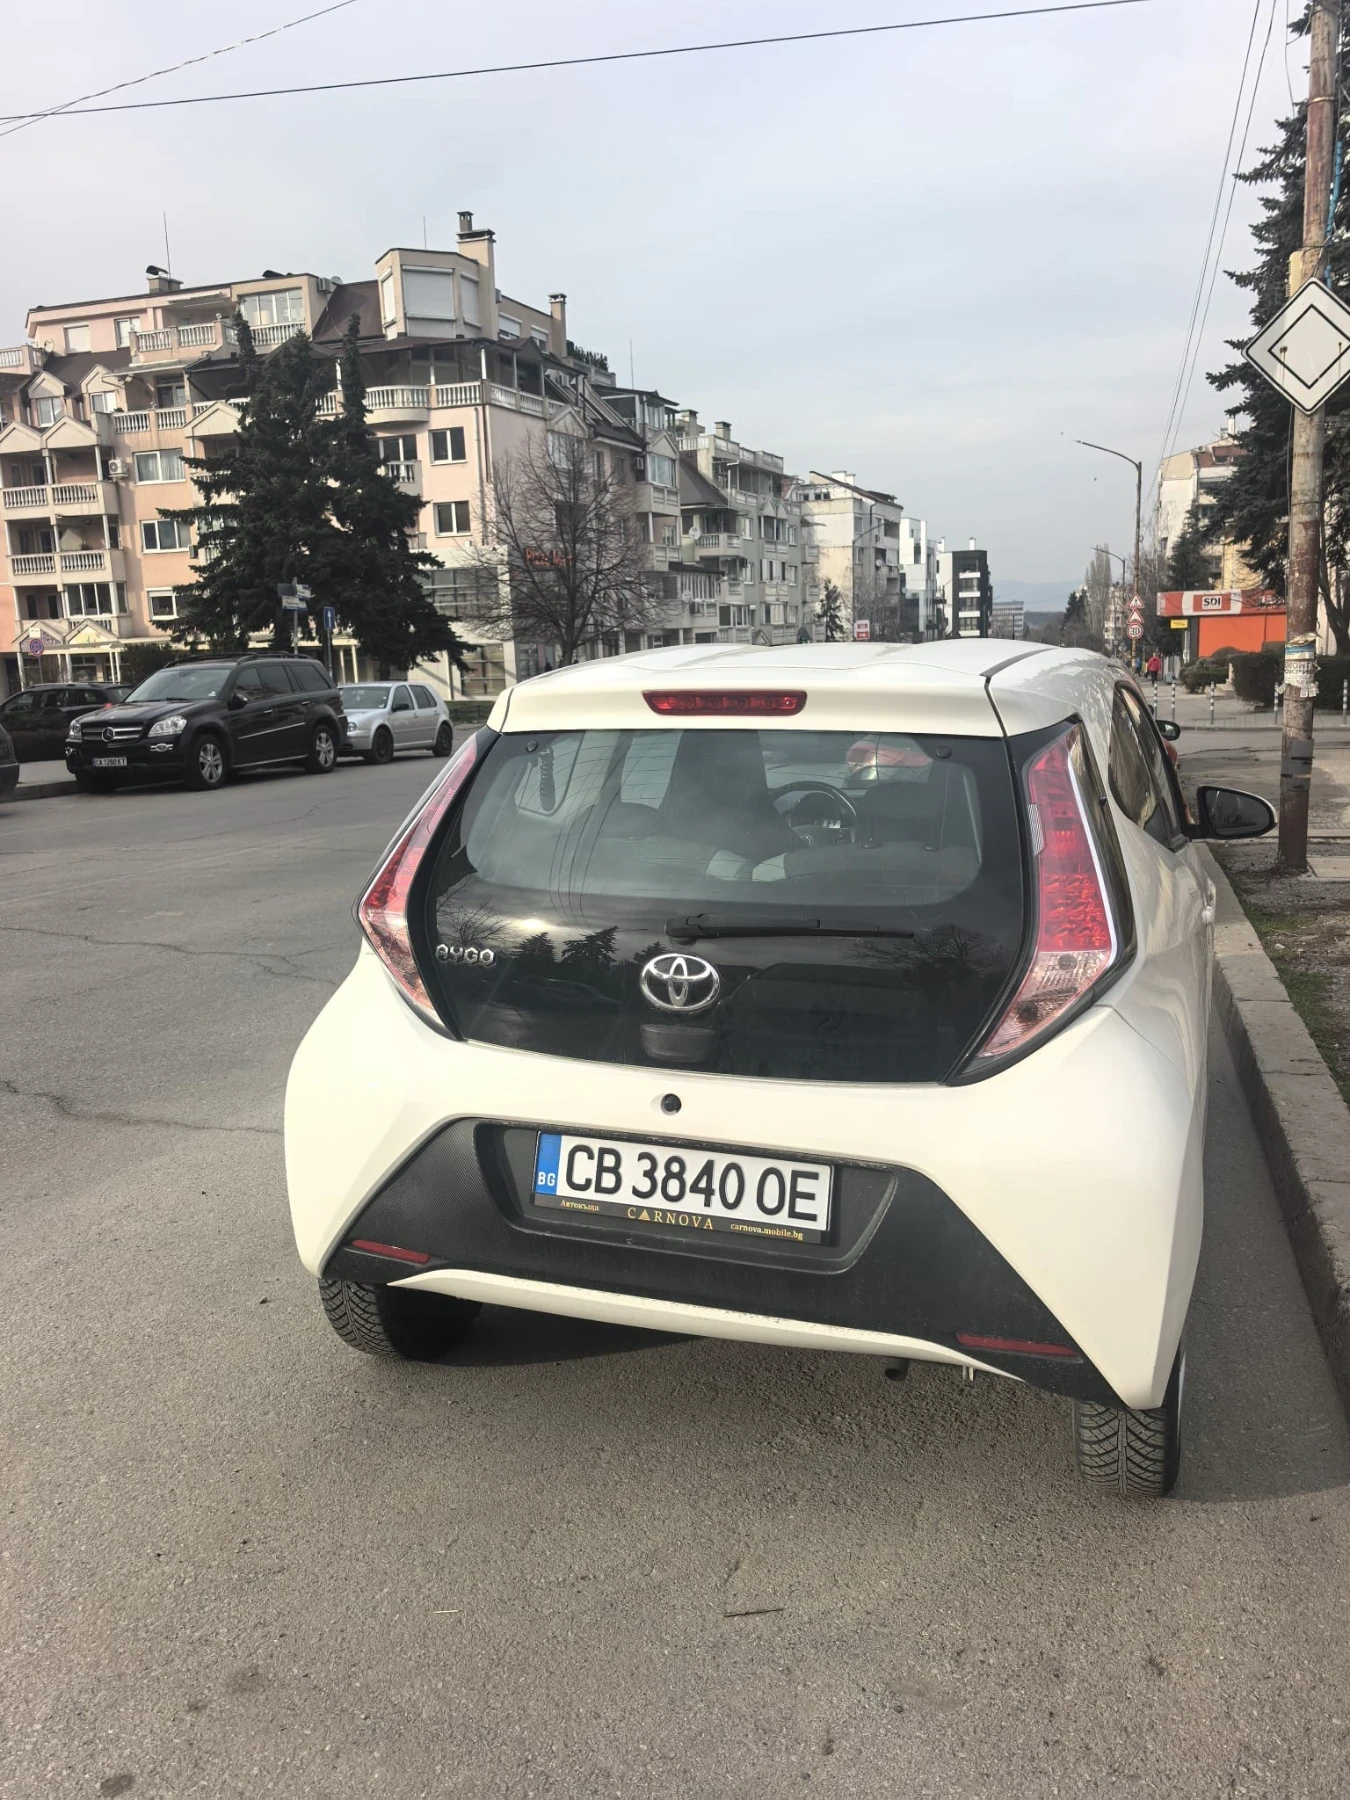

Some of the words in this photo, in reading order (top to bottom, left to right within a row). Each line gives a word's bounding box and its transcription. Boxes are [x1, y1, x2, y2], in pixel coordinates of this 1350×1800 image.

[1203, 597, 1221, 606] SDI
[436, 944, 495, 966] AYGO
[537, 1171, 556, 1187] BG
[565, 1144, 622, 1195] CB
[631, 1151, 745, 1211] 3840
[756, 1166, 820, 1222] OE
[627, 1207, 714, 1230] CARNOVA
[730, 1222, 804, 1240] carnova.mobile.bg
